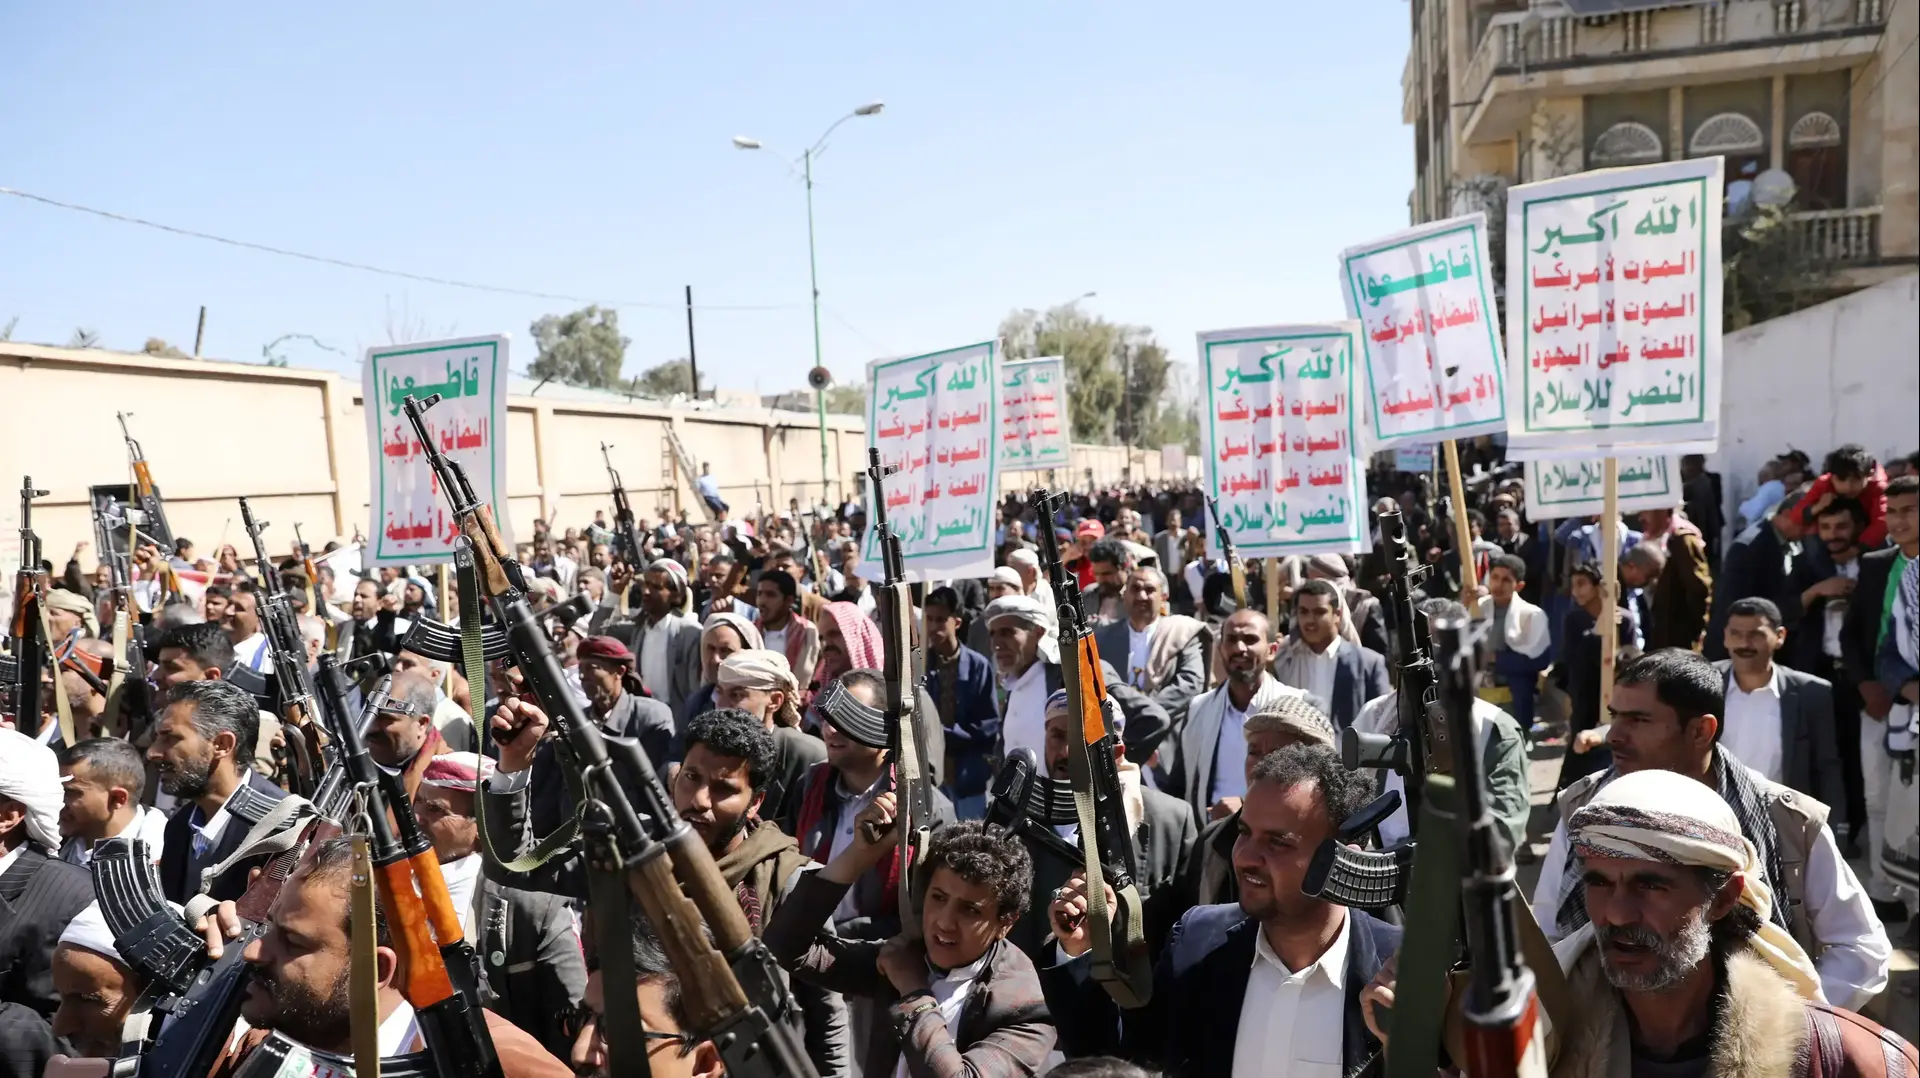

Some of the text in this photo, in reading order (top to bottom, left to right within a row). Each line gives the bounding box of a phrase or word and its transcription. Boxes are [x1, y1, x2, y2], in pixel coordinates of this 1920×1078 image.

[1531, 194, 1696, 259] الله أكبر
[1357, 244, 1473, 308] قاطعوا
[1533, 249, 1696, 292] الموت لأمريكا
[1429, 293, 1480, 337] البضائع
[1623, 292, 1696, 326] الموت
[1216, 342, 1346, 396] الله أكبر
[1532, 334, 1696, 373] اللعنة على اليهود
[383, 356, 480, 417] قاطعوا
[879, 356, 988, 413] الله أكبر
[1620, 369, 1696, 417] النصر
[937, 402, 987, 432] الموت
[1291, 393, 1345, 421] الموت
[440, 415, 488, 456] البضائع
[936, 438, 986, 468] الموت
[1292, 429, 1347, 457] الموت
[1221, 468, 1269, 497] اليهود
[1275, 468, 1300, 493] على
[1618, 456, 1662, 483] النص
[886, 473, 986, 512] اللعنة على اليهو
[929, 504, 983, 547] النصر
